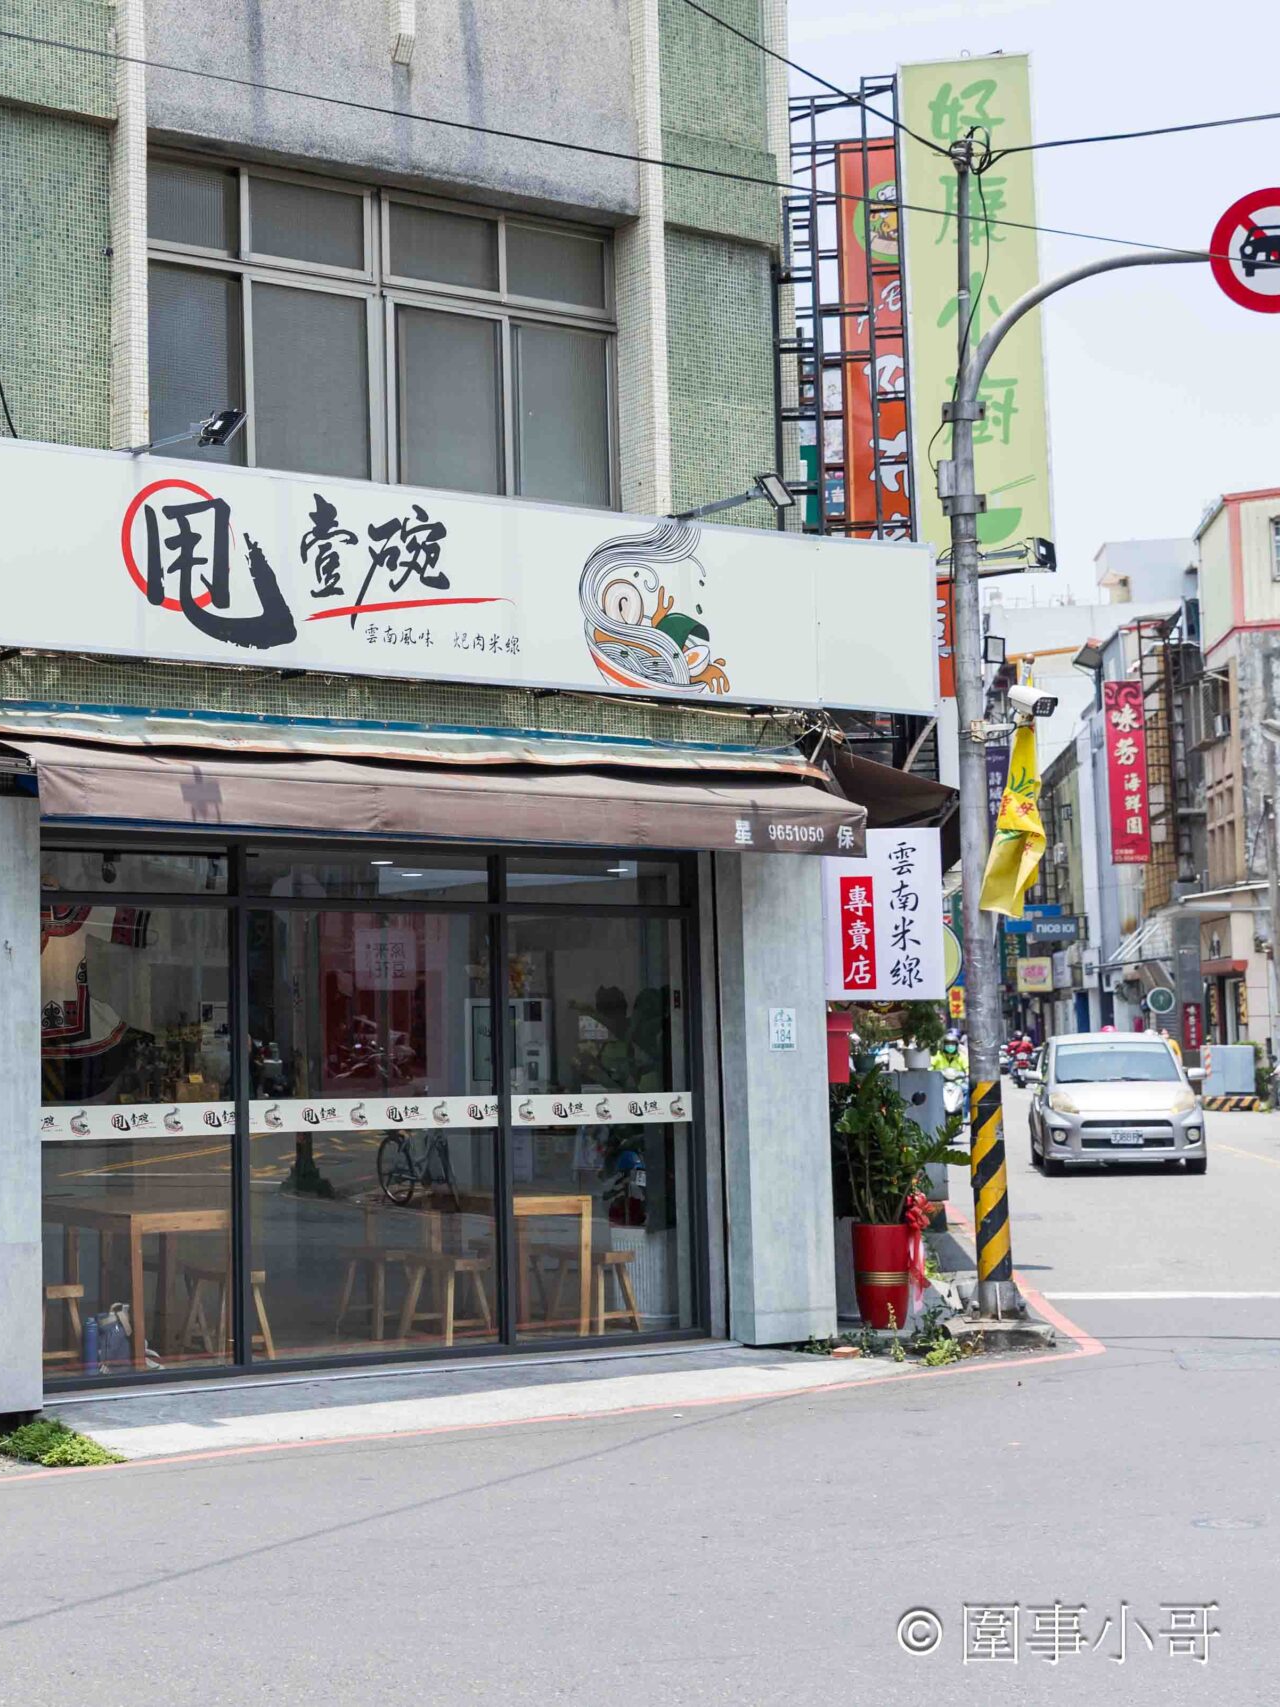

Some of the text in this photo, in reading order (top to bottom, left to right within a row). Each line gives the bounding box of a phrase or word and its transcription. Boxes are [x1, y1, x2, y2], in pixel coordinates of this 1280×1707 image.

[364, 623, 434, 648] 雲南風味
[734, 819, 856, 849] 星 9651050 保
[888, 841, 924, 989] 雲南米線
[1036, 923, 1060, 934] nice
[843, 886, 873, 984] 專賣店
[775, 1029, 792, 1042] 184
